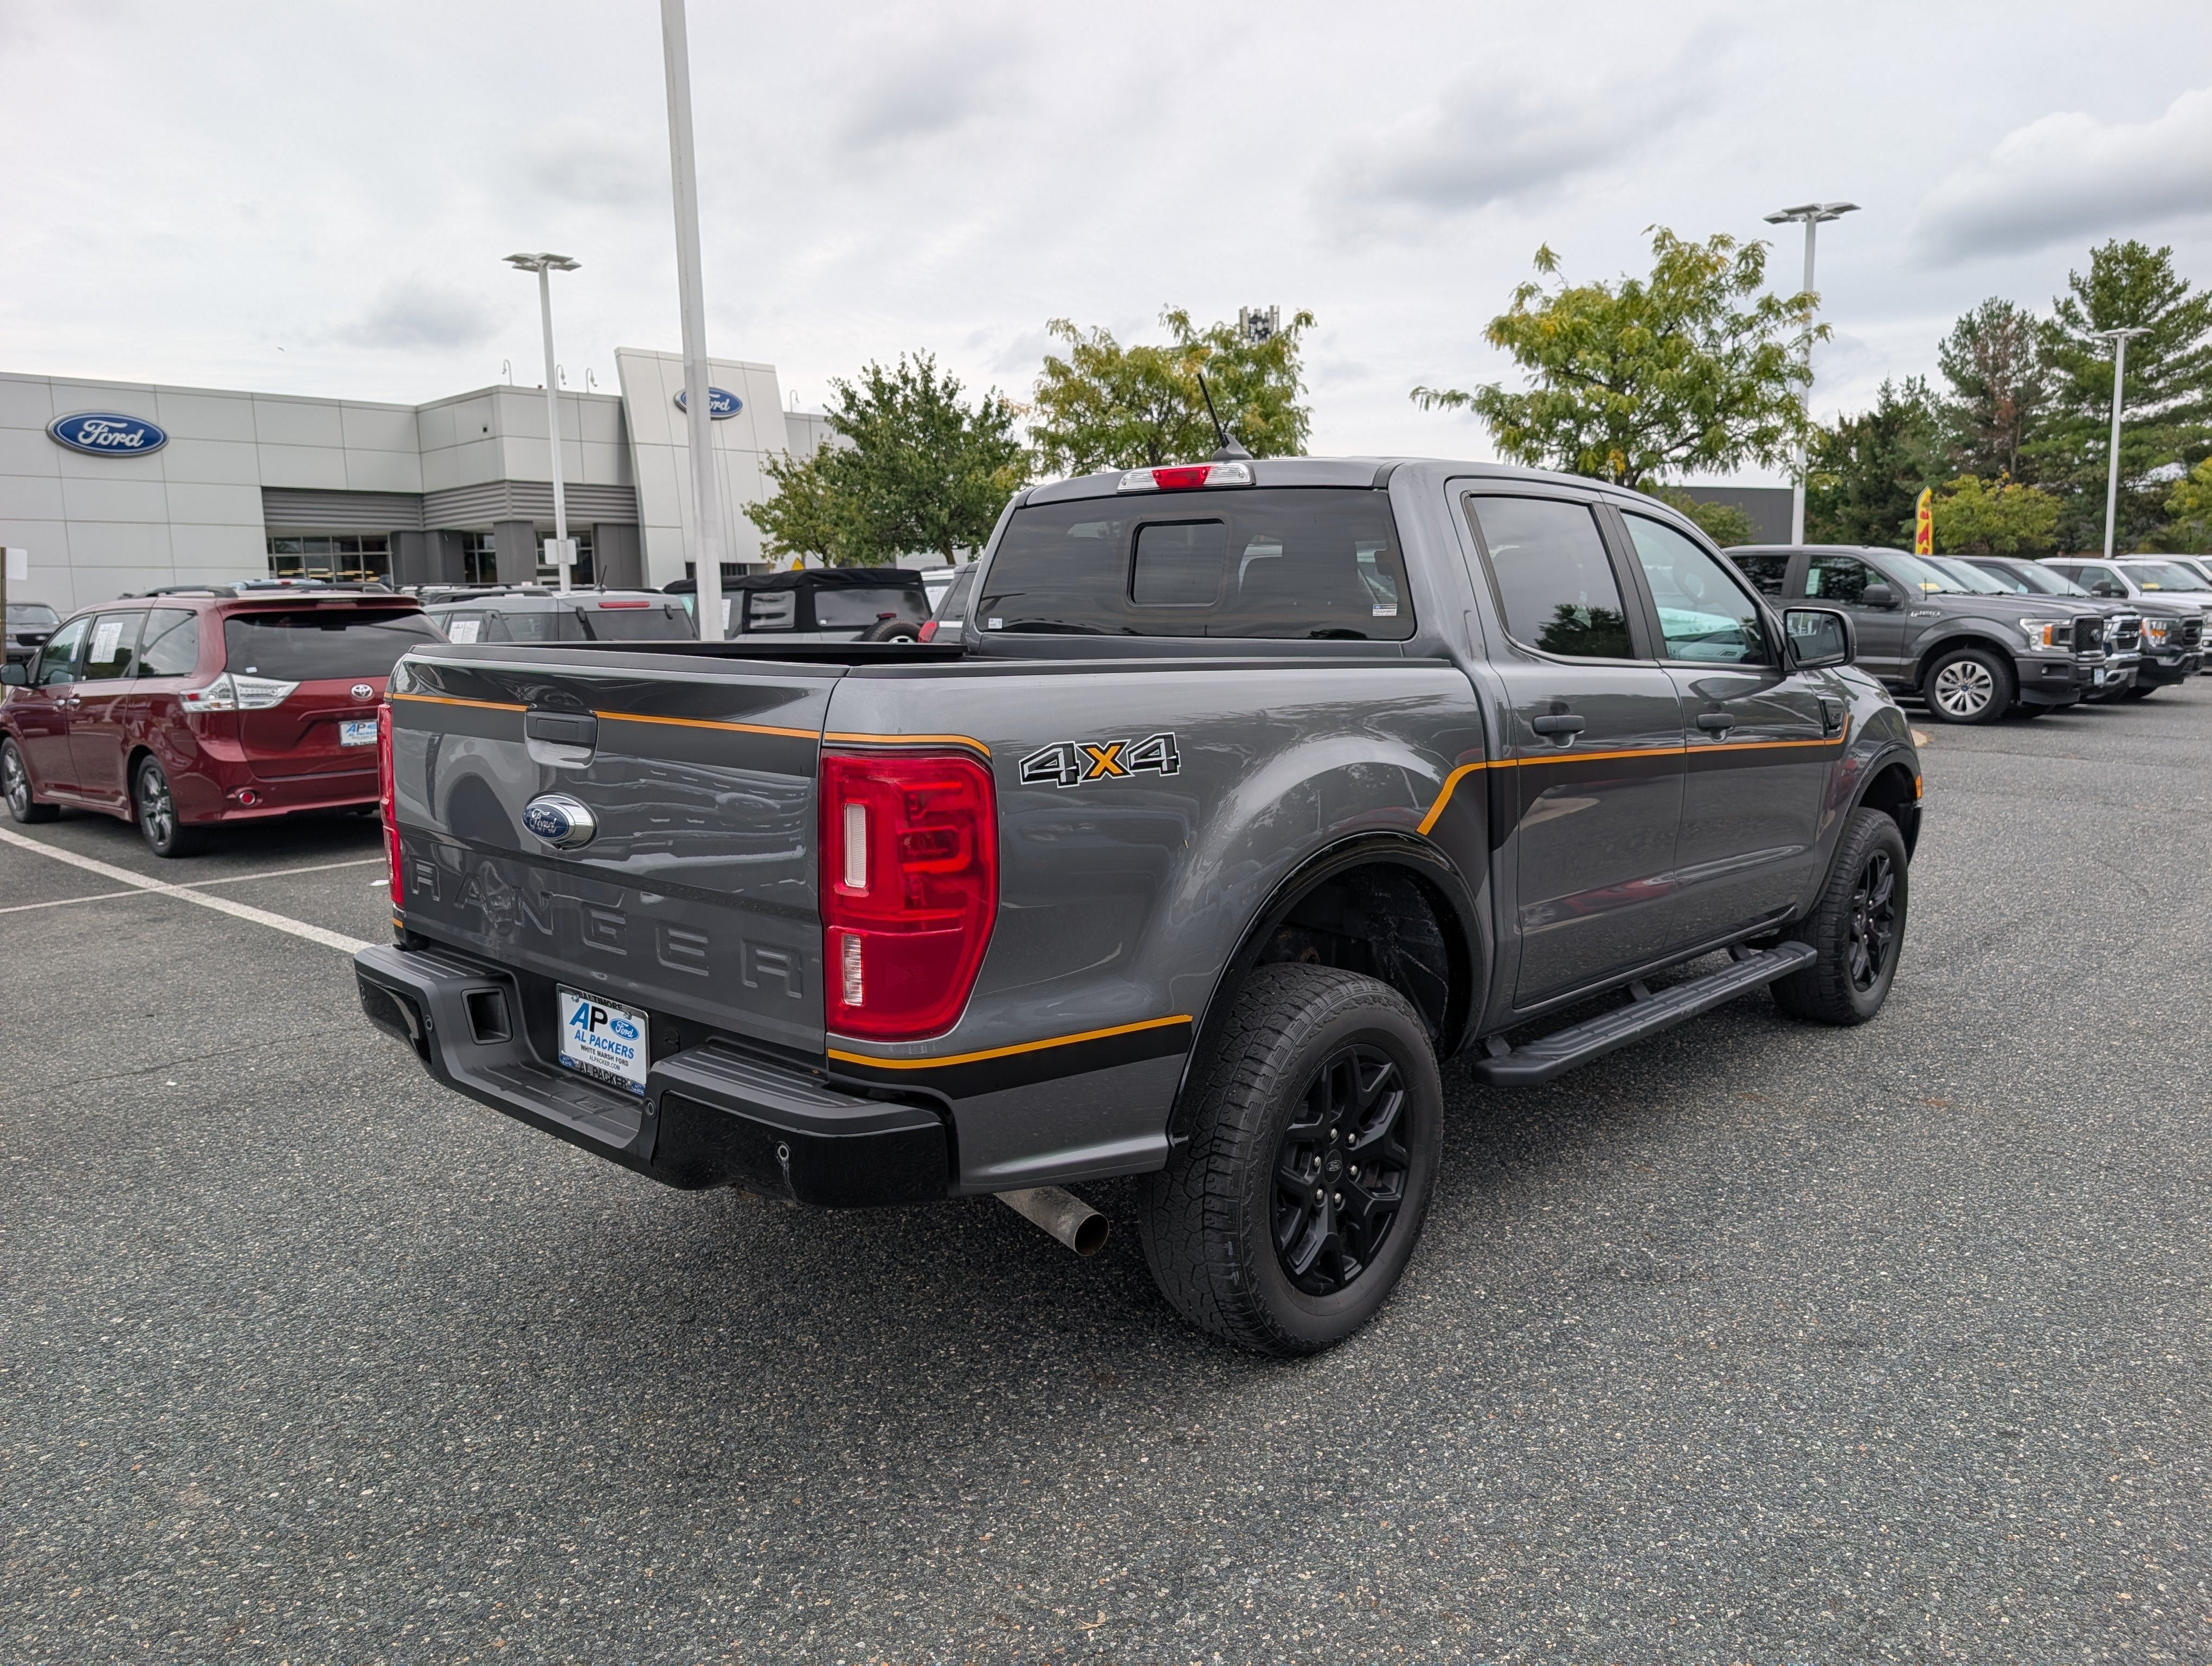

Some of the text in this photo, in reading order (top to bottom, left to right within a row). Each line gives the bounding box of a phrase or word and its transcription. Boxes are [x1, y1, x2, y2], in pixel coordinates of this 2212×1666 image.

[78, 420, 145, 447] Ford
[346, 723, 366, 733] AP
[529, 808, 557, 834] Ford
[410, 857, 803, 999] RANGER
[578, 992, 623, 1011] BALTIMORE
[569, 1002, 608, 1033] AP
[615, 1021, 634, 1038] Ford
[574, 1029, 635, 1059] AL PACKERS
[580, 1044, 629, 1067] WHITE MARSH FORD
[579, 1061, 628, 1088] AL PACKER
[589, 1055, 621, 1071] ALPACKER.COM
